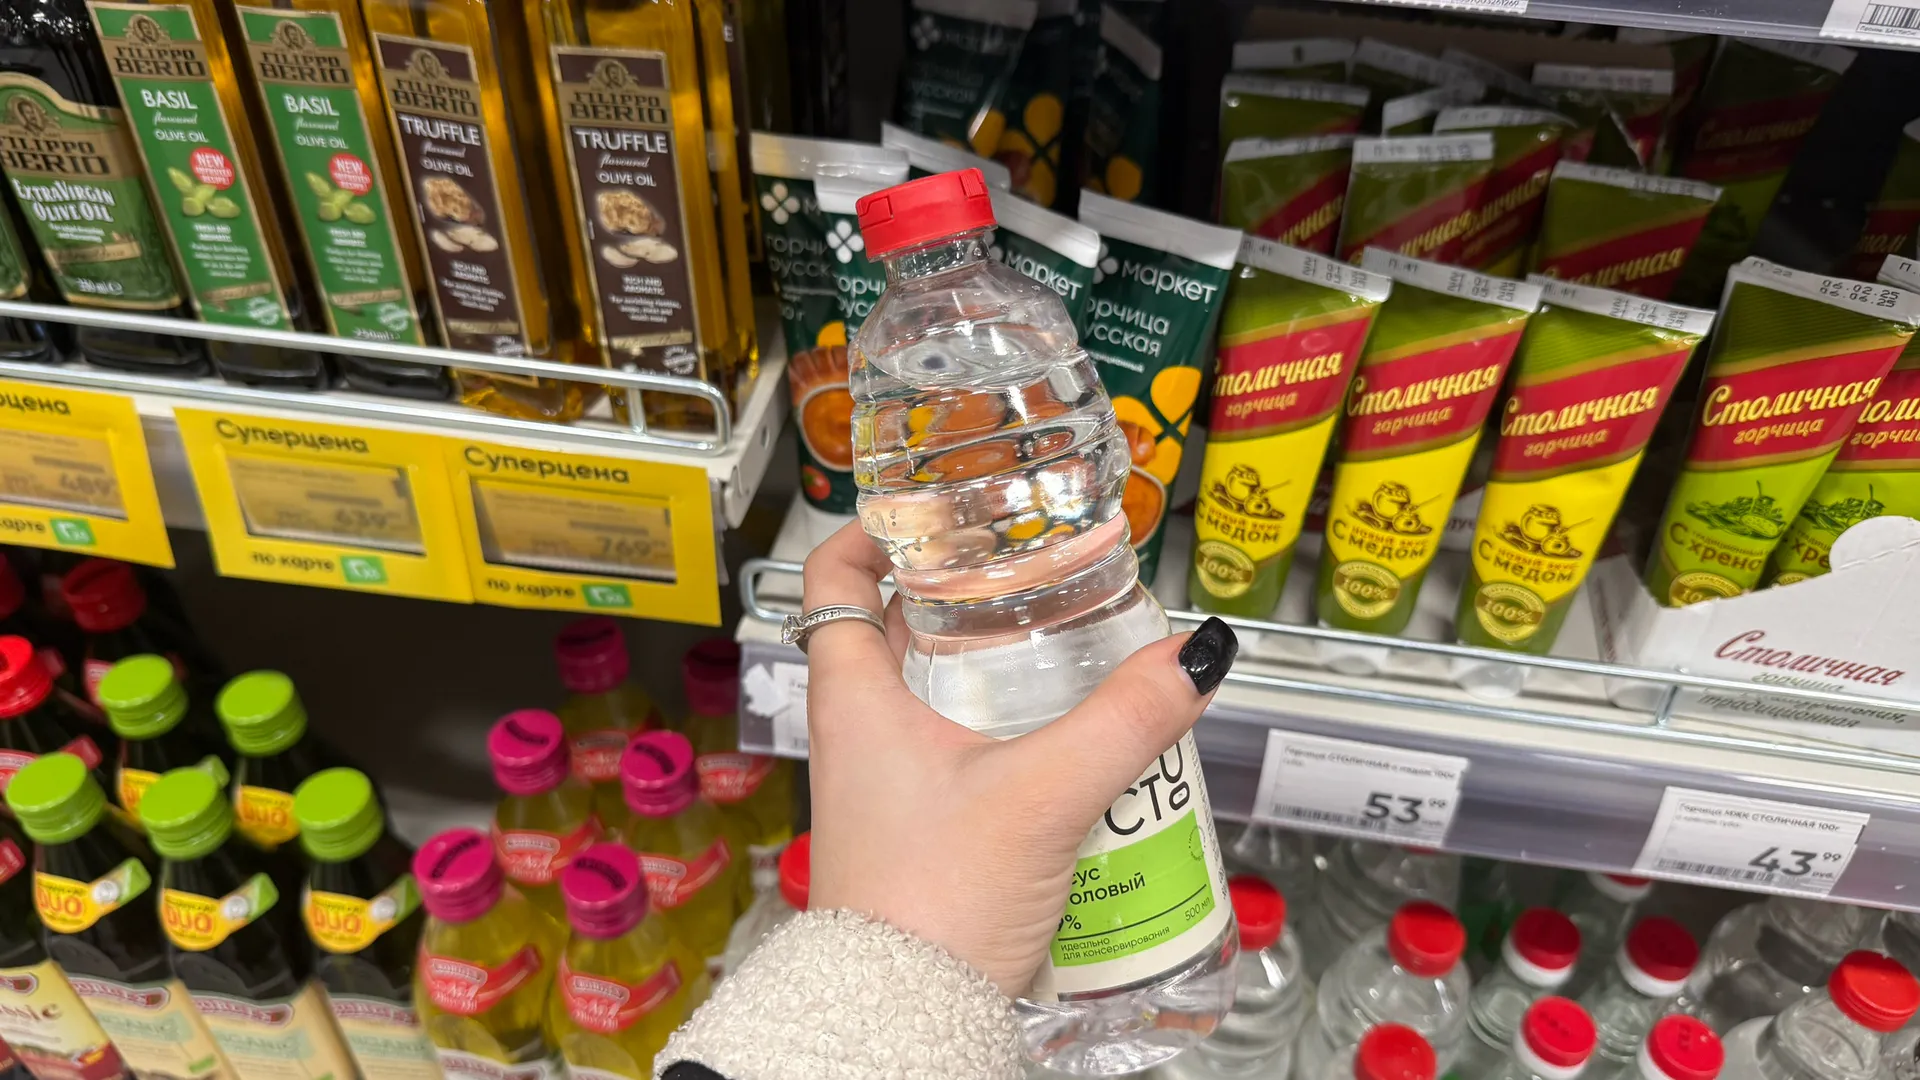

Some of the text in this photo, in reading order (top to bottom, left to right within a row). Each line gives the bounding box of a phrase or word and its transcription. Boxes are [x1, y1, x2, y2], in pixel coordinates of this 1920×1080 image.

[115, 46, 197, 61] FILIPPO
[261, 51, 341, 68] FILIPPO
[114, 57, 207, 77] BERIO
[259, 61, 350, 84] BERIO
[140, 88, 198, 110] BASIL
[396, 78, 471, 101] FILIPPO
[574, 91, 661, 108] FILIPPO
[282, 93, 340, 117] BASIL
[391, 88, 479, 117] BERIO
[569, 101, 668, 124] BERIO
[154, 128, 210, 143] OLIVE OIL
[295, 133, 350, 150] OLIVE OIL
[398, 113, 482, 147] TRUFFLE
[573, 126, 668, 154] TRUFFLE
[0, 134, 96, 155] ILIPPO
[195, 152, 226, 168] NEW
[335, 158, 363, 174] NEW
[420, 156, 475, 178] OLIVE OIL
[596, 170, 657, 188] OLIVE OIL
[32, 200, 115, 223] OLIVE OIL
[1005, 250, 1084, 302] маркет
[1120, 258, 1219, 305] маркет
[1822, 279, 1901, 300] 06.02.25
[1213, 351, 1344, 398] толичная
[1347, 362, 1501, 417] Столичная
[1702, 376, 1882, 427] Столичная
[1226, 391, 1298, 419] горчица
[1502, 386, 1660, 438] Столичная
[1372, 406, 1453, 436] горчица
[1733, 418, 1824, 445] горчица
[215, 418, 370, 453] Суперцена
[1524, 428, 1608, 459] горчица
[463, 446, 630, 484] Суперцена
[0, 517, 46, 533] арте
[1206, 514, 1280, 544] медом
[1669, 521, 1689, 546] С
[1332, 519, 1426, 561] С медом
[279, 555, 335, 572] карте
[1201, 555, 1245, 581] 100%
[1478, 538, 1574, 585] С медом
[486, 577, 511, 592] по
[515, 582, 576, 599] карте
[1342, 577, 1389, 601] 100%
[1484, 599, 1533, 622] 100%
[1713, 628, 1906, 687] Столичная
[1361, 789, 1424, 825] 53
[1751, 813, 1816, 828] СТОЛИЧНАЯ
[1818, 821, 1841, 832] 100г
[1748, 846, 1843, 877] 43 99
[1184, 903, 1201, 921] 500
[1060, 937, 1111, 951] идеально
[1062, 926, 1171, 961] для консервирования
